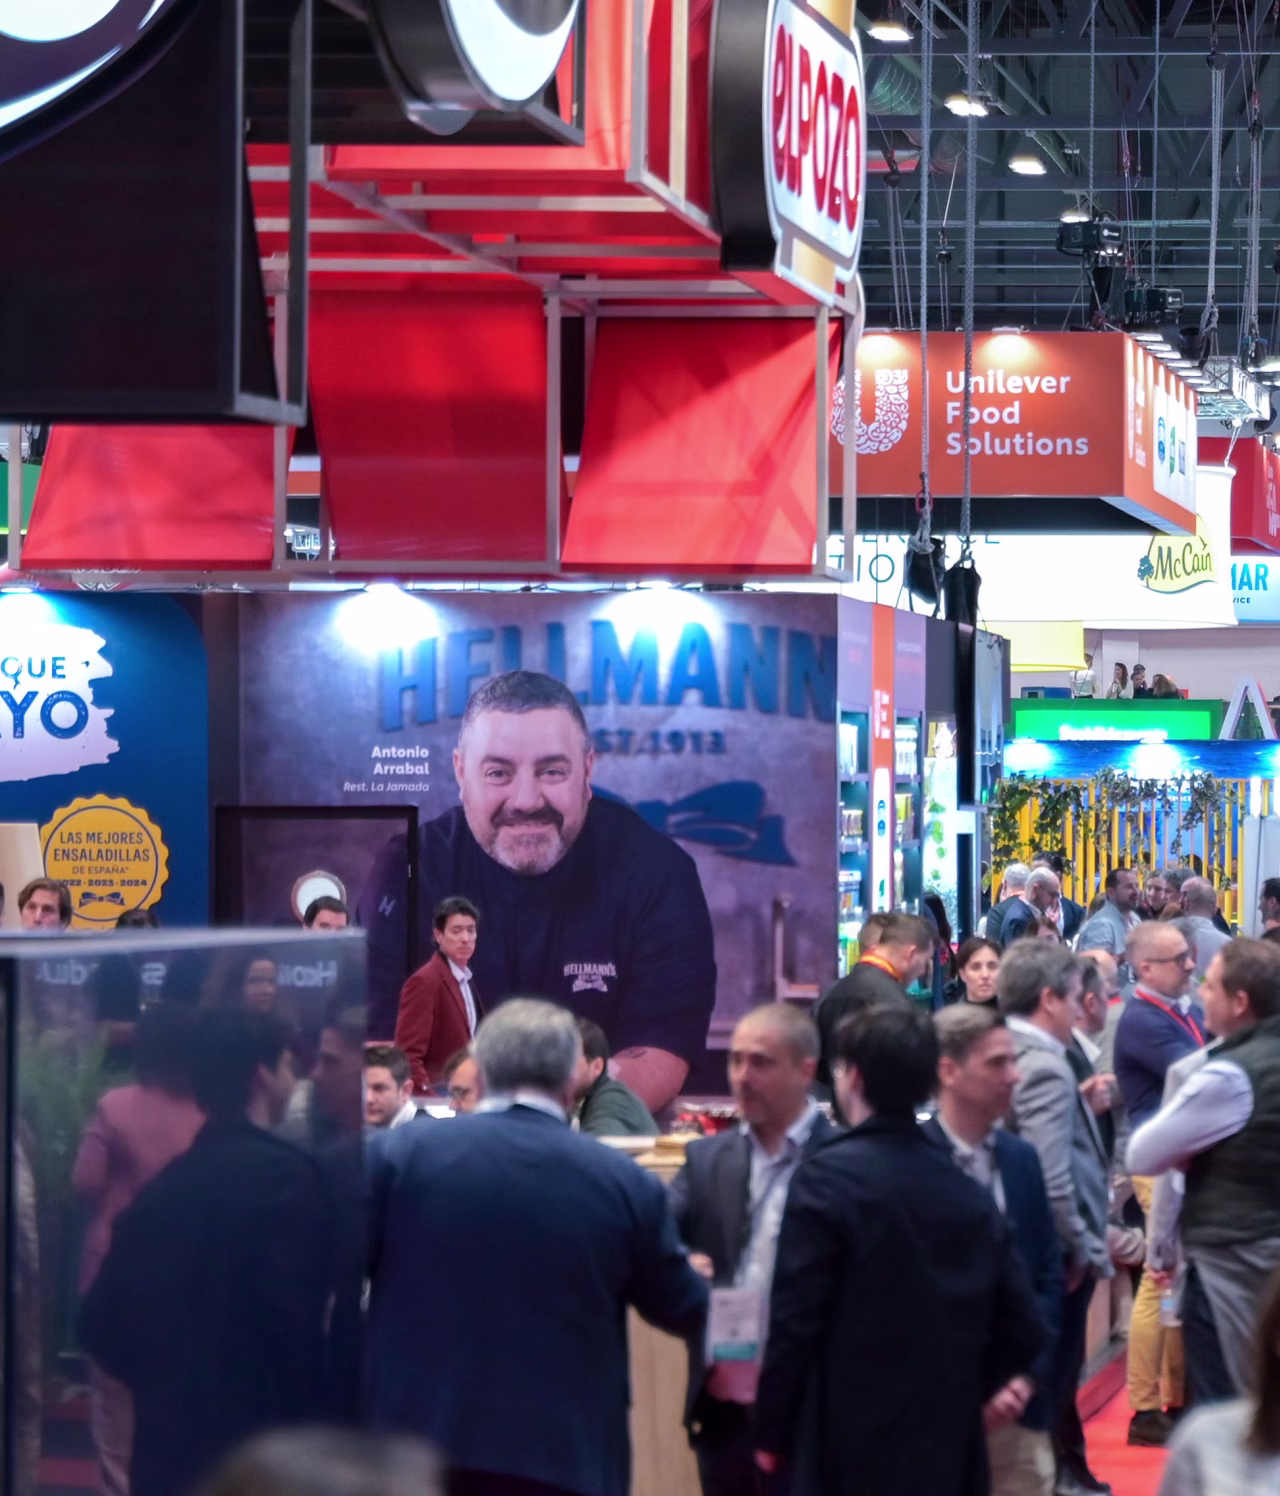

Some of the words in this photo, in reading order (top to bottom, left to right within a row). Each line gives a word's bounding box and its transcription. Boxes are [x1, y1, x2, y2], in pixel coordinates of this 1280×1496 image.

[946, 370, 1071, 394] Unilever
[946, 400, 1021, 425] Food
[946, 431, 1089, 456] Solutions
[1154, 542, 1213, 580] McCain
[0, 656, 66, 690] QUE
[0, 690, 89, 739] YO
[371, 745, 430, 758] Antonio
[373, 762, 430, 775] Arrabal
[343, 782, 369, 792] Rest.
[371, 782, 384, 792] La
[386, 781, 430, 792] Jamada
[60, 832, 82, 844] LAS
[86, 832, 143, 844] MEJORES
[53, 848, 150, 861] ENSALADILLAS
[72, 866, 85, 875] DE
